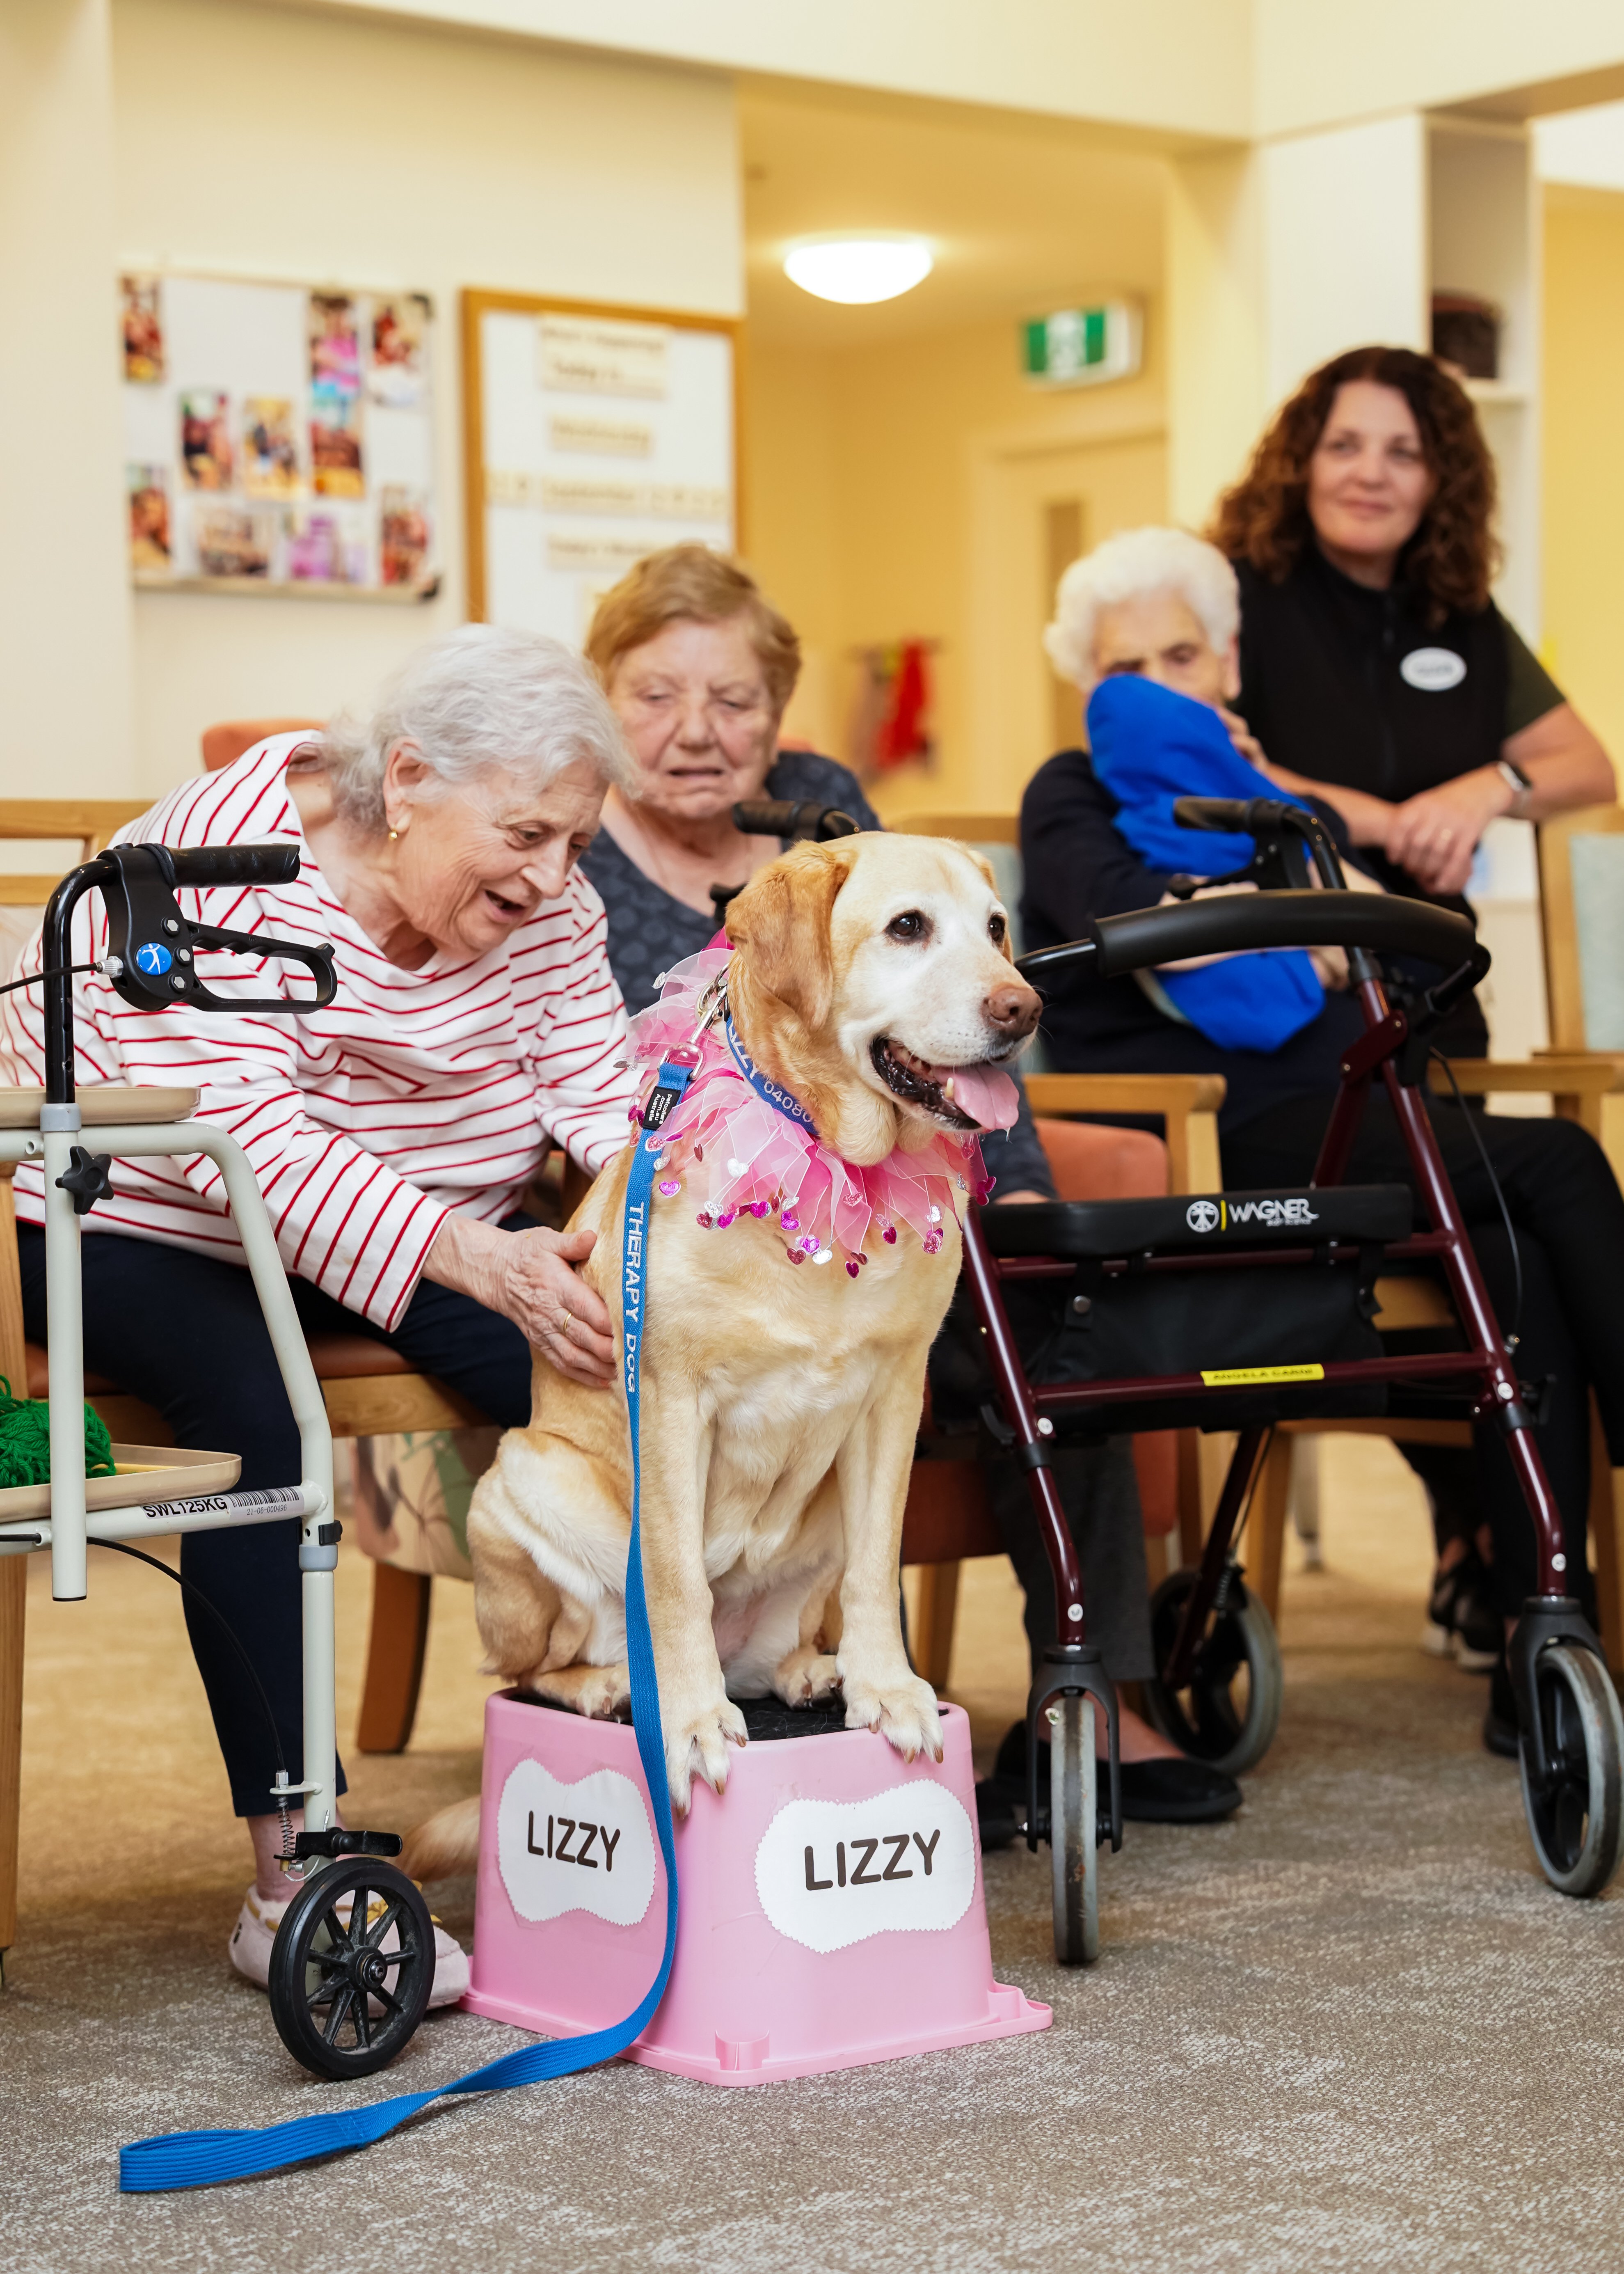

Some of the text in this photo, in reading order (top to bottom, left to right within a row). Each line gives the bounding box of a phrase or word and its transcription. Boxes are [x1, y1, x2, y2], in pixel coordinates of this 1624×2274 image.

[648, 1093, 661, 1121] Australia
[654, 1095, 665, 1121] .com.au
[659, 1093, 672, 1124] petcollars
[1229, 1198, 1320, 1223] WAGNER
[625, 1202, 644, 1393] THERAPY DOG
[142, 1497, 228, 1518] SWL125KG
[247, 1504, 287, 1516] 21-06-000496
[528, 1810, 620, 1871] LIZZY
[804, 1829, 940, 1891] LIZZY
